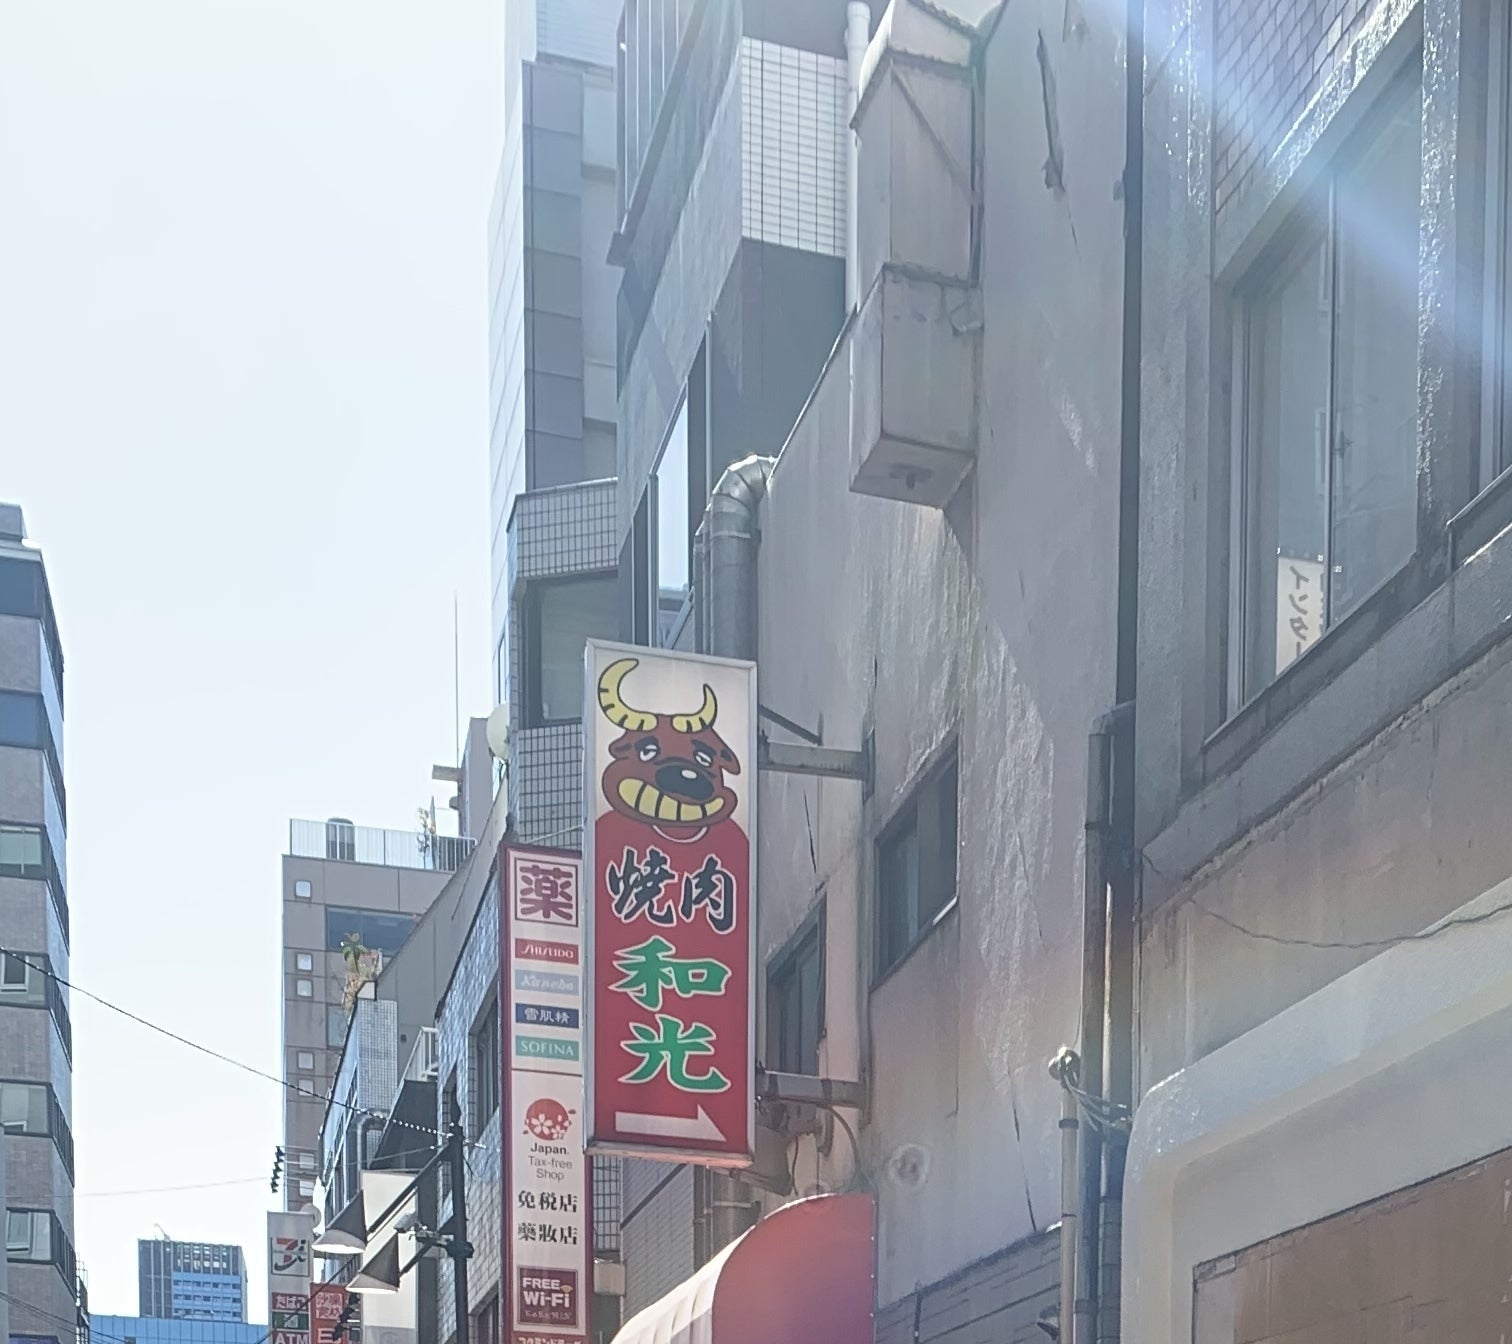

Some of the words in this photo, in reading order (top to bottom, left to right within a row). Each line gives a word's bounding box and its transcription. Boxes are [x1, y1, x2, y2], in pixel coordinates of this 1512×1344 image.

[519, 864, 574, 921] 薬
[606, 845, 737, 934] 焼肉
[523, 1006, 570, 1024] 雪肌精
[608, 935, 731, 1094] 和光
[520, 1039, 575, 1057] SOFINA
[527, 1156, 573, 1170] Tax-free
[535, 1167, 565, 1182] Shop
[517, 1189, 578, 1213] 免税店
[522, 1277, 561, 1291] FREE
[522, 1290, 570, 1308] Wi-Fi
